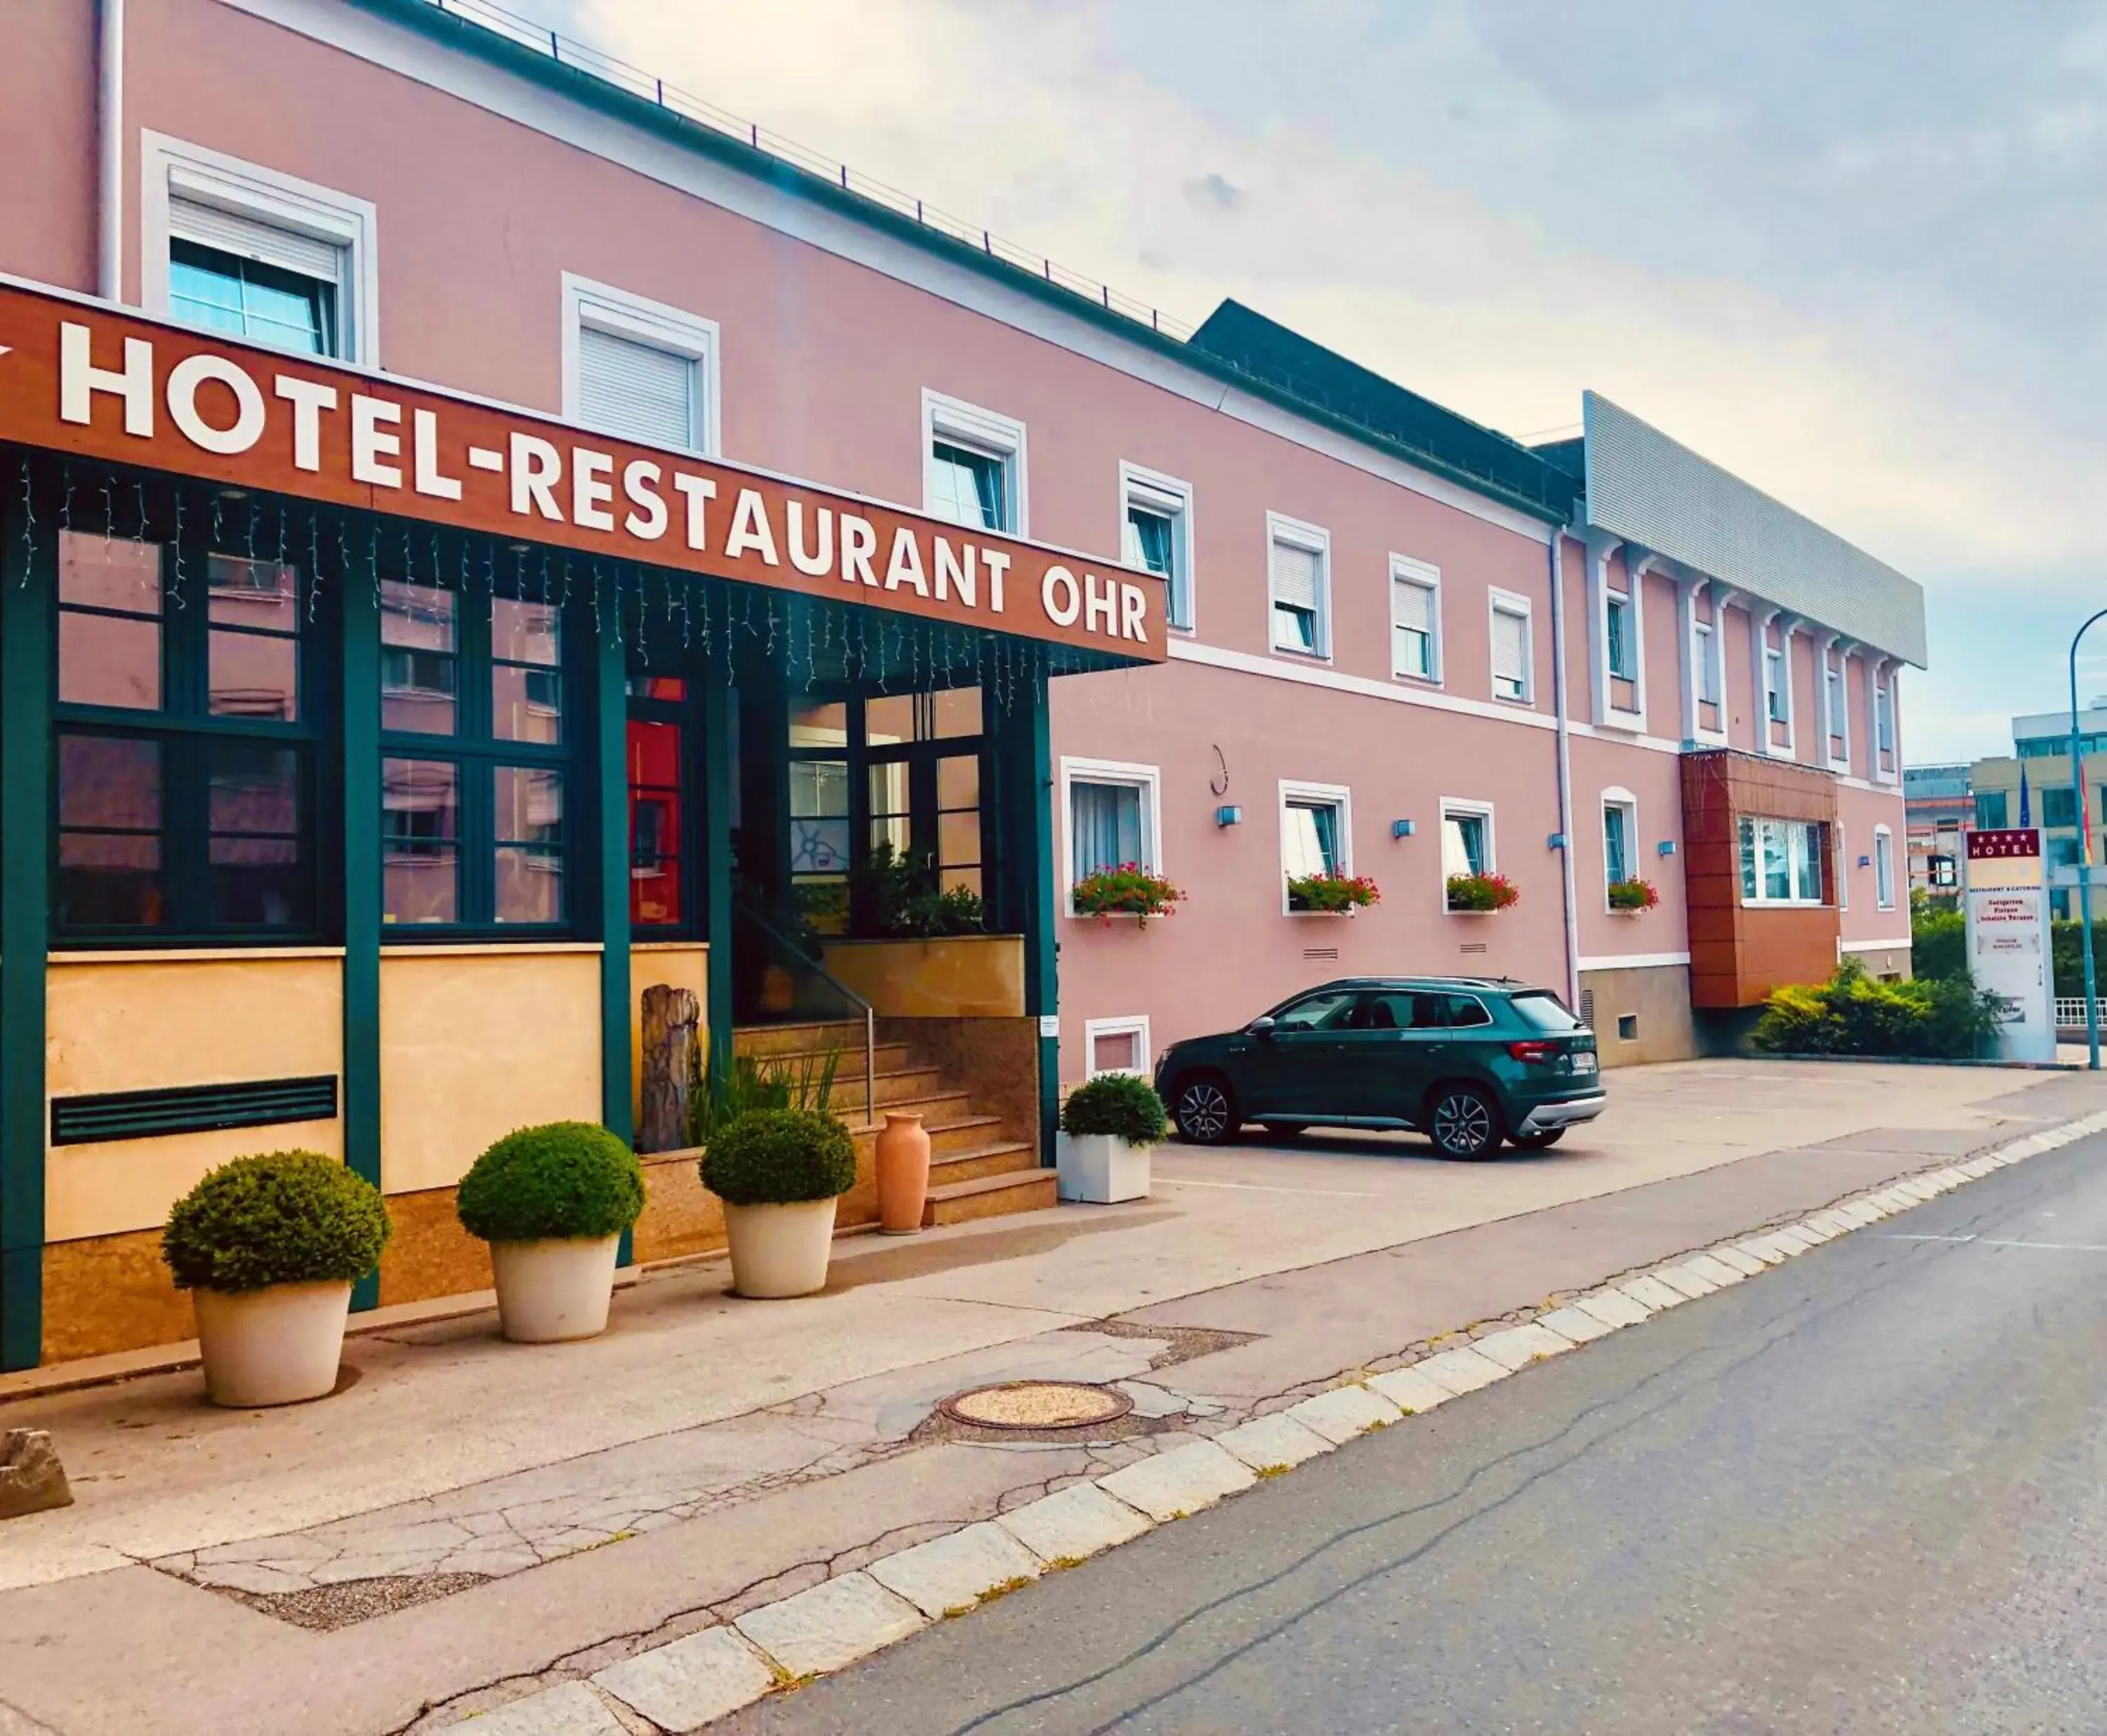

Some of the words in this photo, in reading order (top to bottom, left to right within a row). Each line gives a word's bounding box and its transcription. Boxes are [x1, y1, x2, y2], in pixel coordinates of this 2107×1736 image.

[60, 321, 1011, 612] HOTEL-RESTAURANT
[1042, 565, 1148, 643] OHR
[1973, 844, 2034, 856] HOTEL
